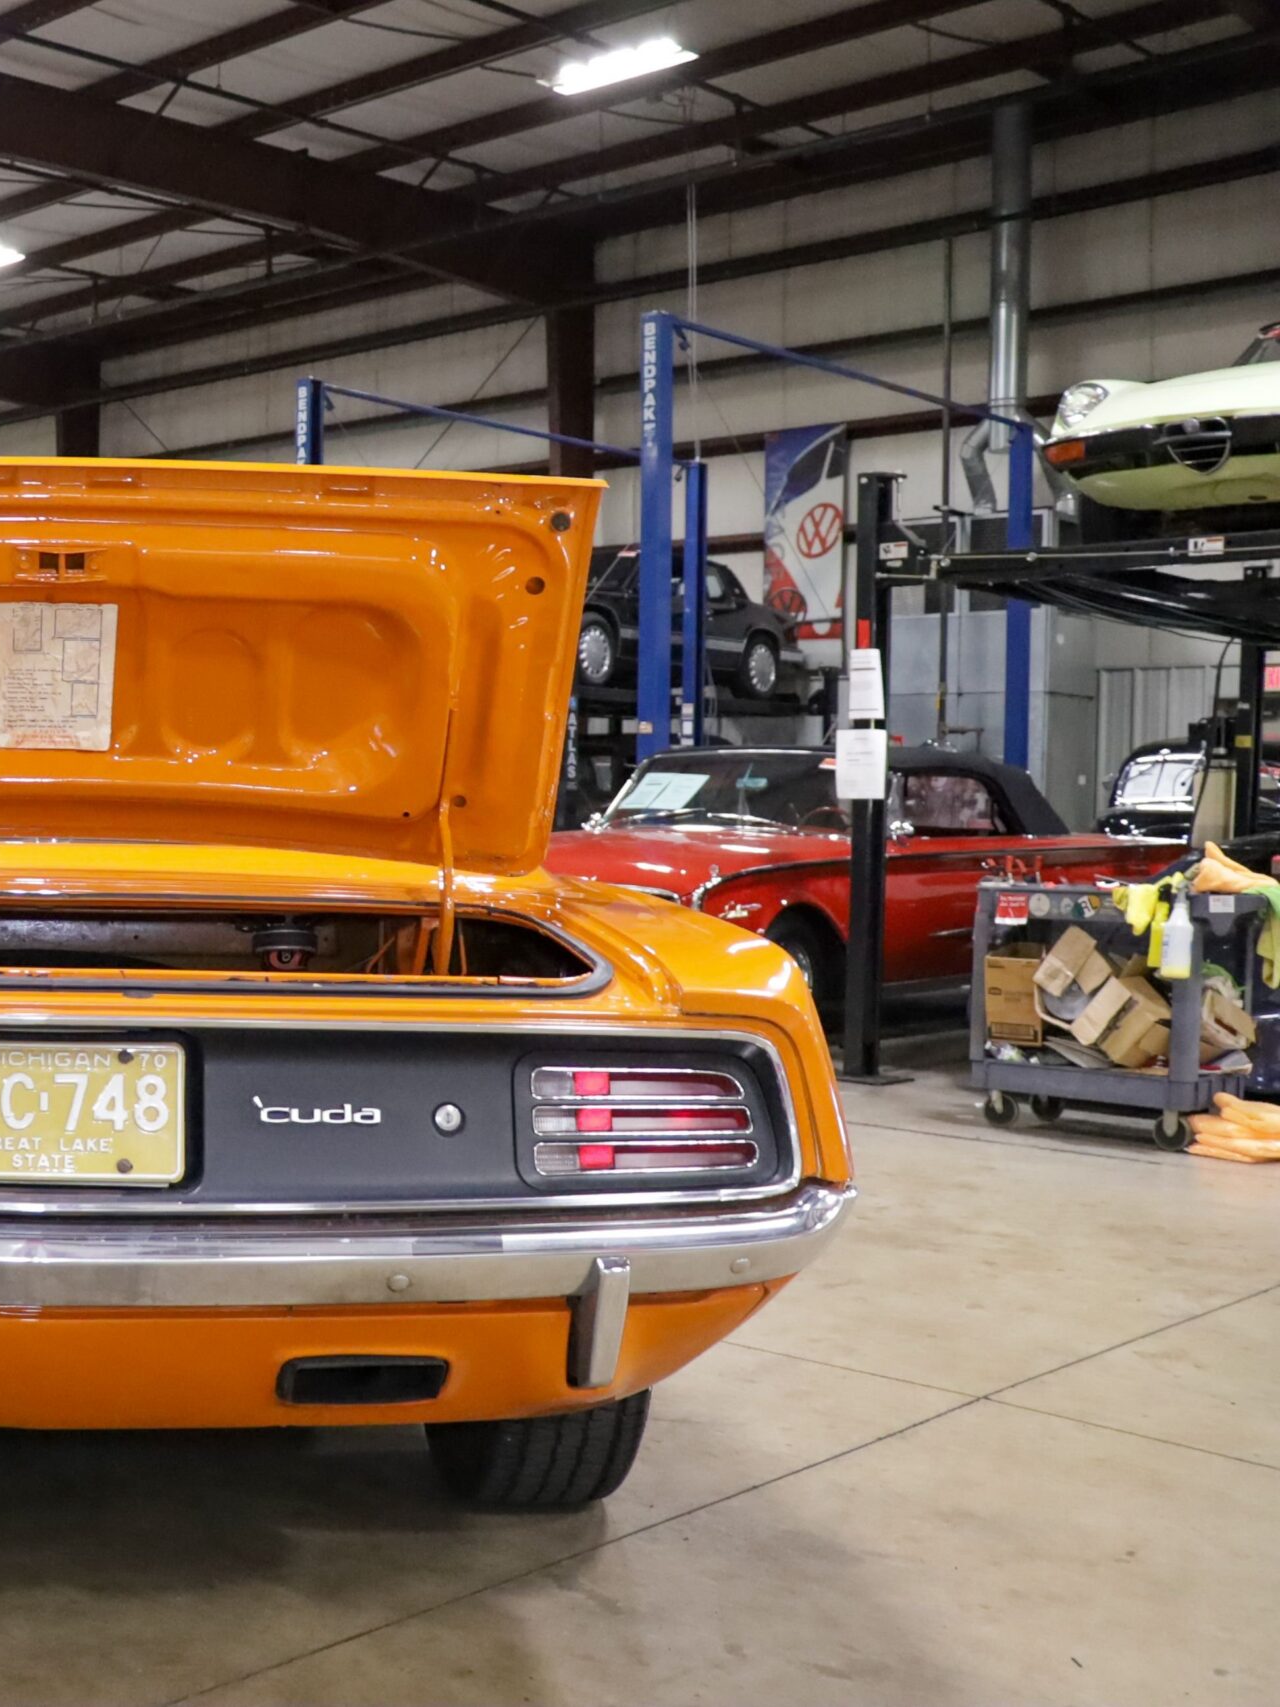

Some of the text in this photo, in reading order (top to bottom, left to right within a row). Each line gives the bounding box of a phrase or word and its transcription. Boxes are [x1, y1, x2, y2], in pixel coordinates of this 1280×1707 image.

[643, 321, 656, 421] BENDPAK
[567, 712, 578, 778] ATLAS
[139, 1053, 167, 1068] 70
[12, 1154, 76, 1169] STATE
